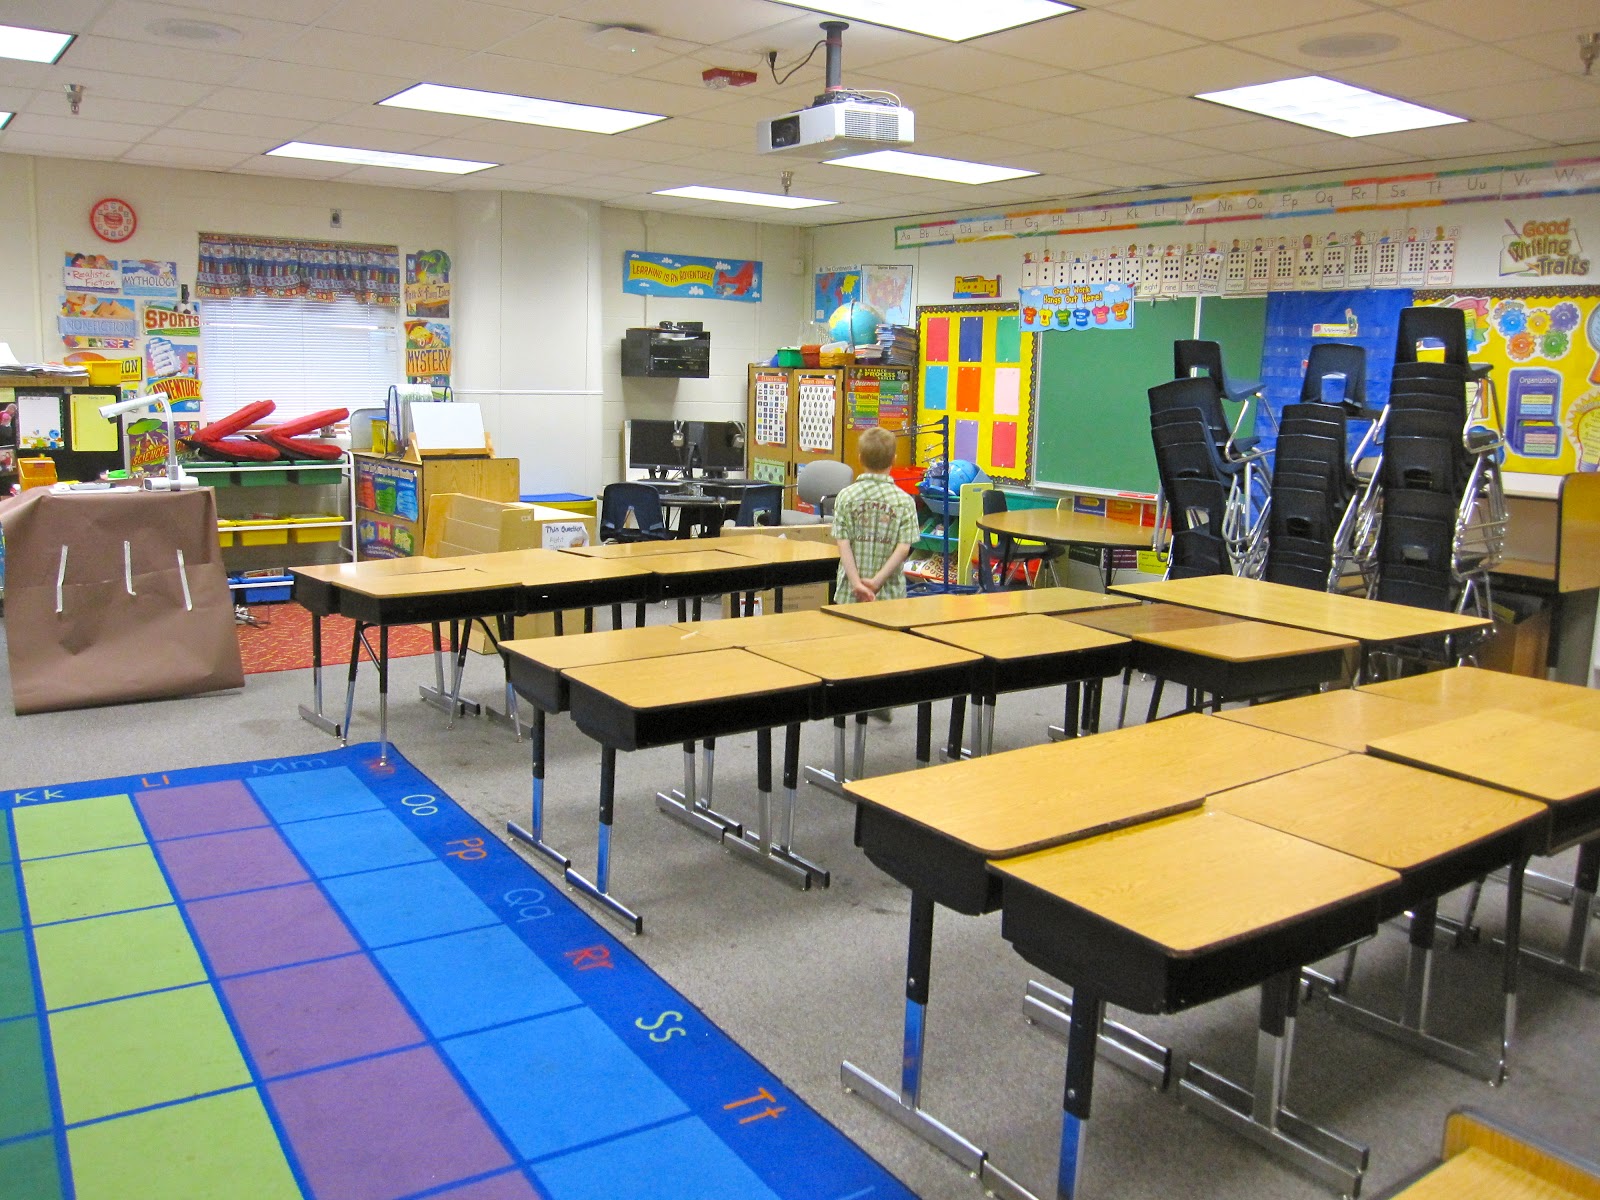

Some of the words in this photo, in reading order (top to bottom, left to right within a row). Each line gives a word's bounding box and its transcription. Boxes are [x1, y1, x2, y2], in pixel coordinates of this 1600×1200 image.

[900, 231, 911, 241] Aa
[919, 229, 929, 238] Bb
[938, 226, 949, 237] Cc
[959, 224, 972, 234] Dd
[983, 222, 993, 232] Ee
[1004, 219, 1013, 230] Ff
[1024, 217, 1039, 232] Gg
[1052, 215, 1065, 226] Hh
[1100, 210, 1113, 226] Jj
[1126, 207, 1140, 219] Kk
[1154, 205, 1165, 217] Ll
[1184, 203, 1205, 214] Mm
[1217, 200, 1233, 212] Nn
[1246, 197, 1263, 210] Oo
[1281, 194, 1298, 210] Pp
[1351, 186, 1367, 200] Rr
[1390, 184, 1406, 198] Ss
[1426, 180, 1442, 195] Tt
[1466, 178, 1487, 191] Uu
[1513, 172, 1532, 187] Vv
[1554, 168, 1586, 183] Ww
[1522, 218, 1570, 238] Good
[1507, 235, 1572, 263] Writing
[72, 270, 111, 279] Realistic
[632, 263, 663, 279] LEARNING
[663, 273, 670, 283] IS
[671, 274, 679, 283] AN
[679, 270, 714, 282] ADVENTURE!
[1536, 255, 1590, 277] Traits
[85, 279, 116, 287] Fiction
[123, 275, 176, 288] MYTHOLOGY
[954, 275, 998, 298] Reading
[1053, 286, 1071, 295] Great
[1073, 285, 1091, 294] Work
[1143, 283, 1158, 293] eight
[1043, 294, 1062, 305] Hangs
[1065, 295, 1078, 304] Out
[1081, 292, 1103, 303] Here!
[66, 320, 133, 334] NON-FICTION
[145, 309, 200, 330] SPORTS
[407, 349, 451, 374] MYSTERY
[153, 379, 200, 402] ADVENTURE
[1519, 376, 1558, 386] Organization
[251, 756, 328, 775] Mm
[14, 788, 66, 803] Kk
[400, 793, 440, 817] Oo
[446, 836, 488, 862] Pp
[502, 887, 555, 922] Qq
[564, 945, 614, 972] Rr
[635, 1010, 687, 1043] Ss
[722, 1087, 787, 1125] Tt
